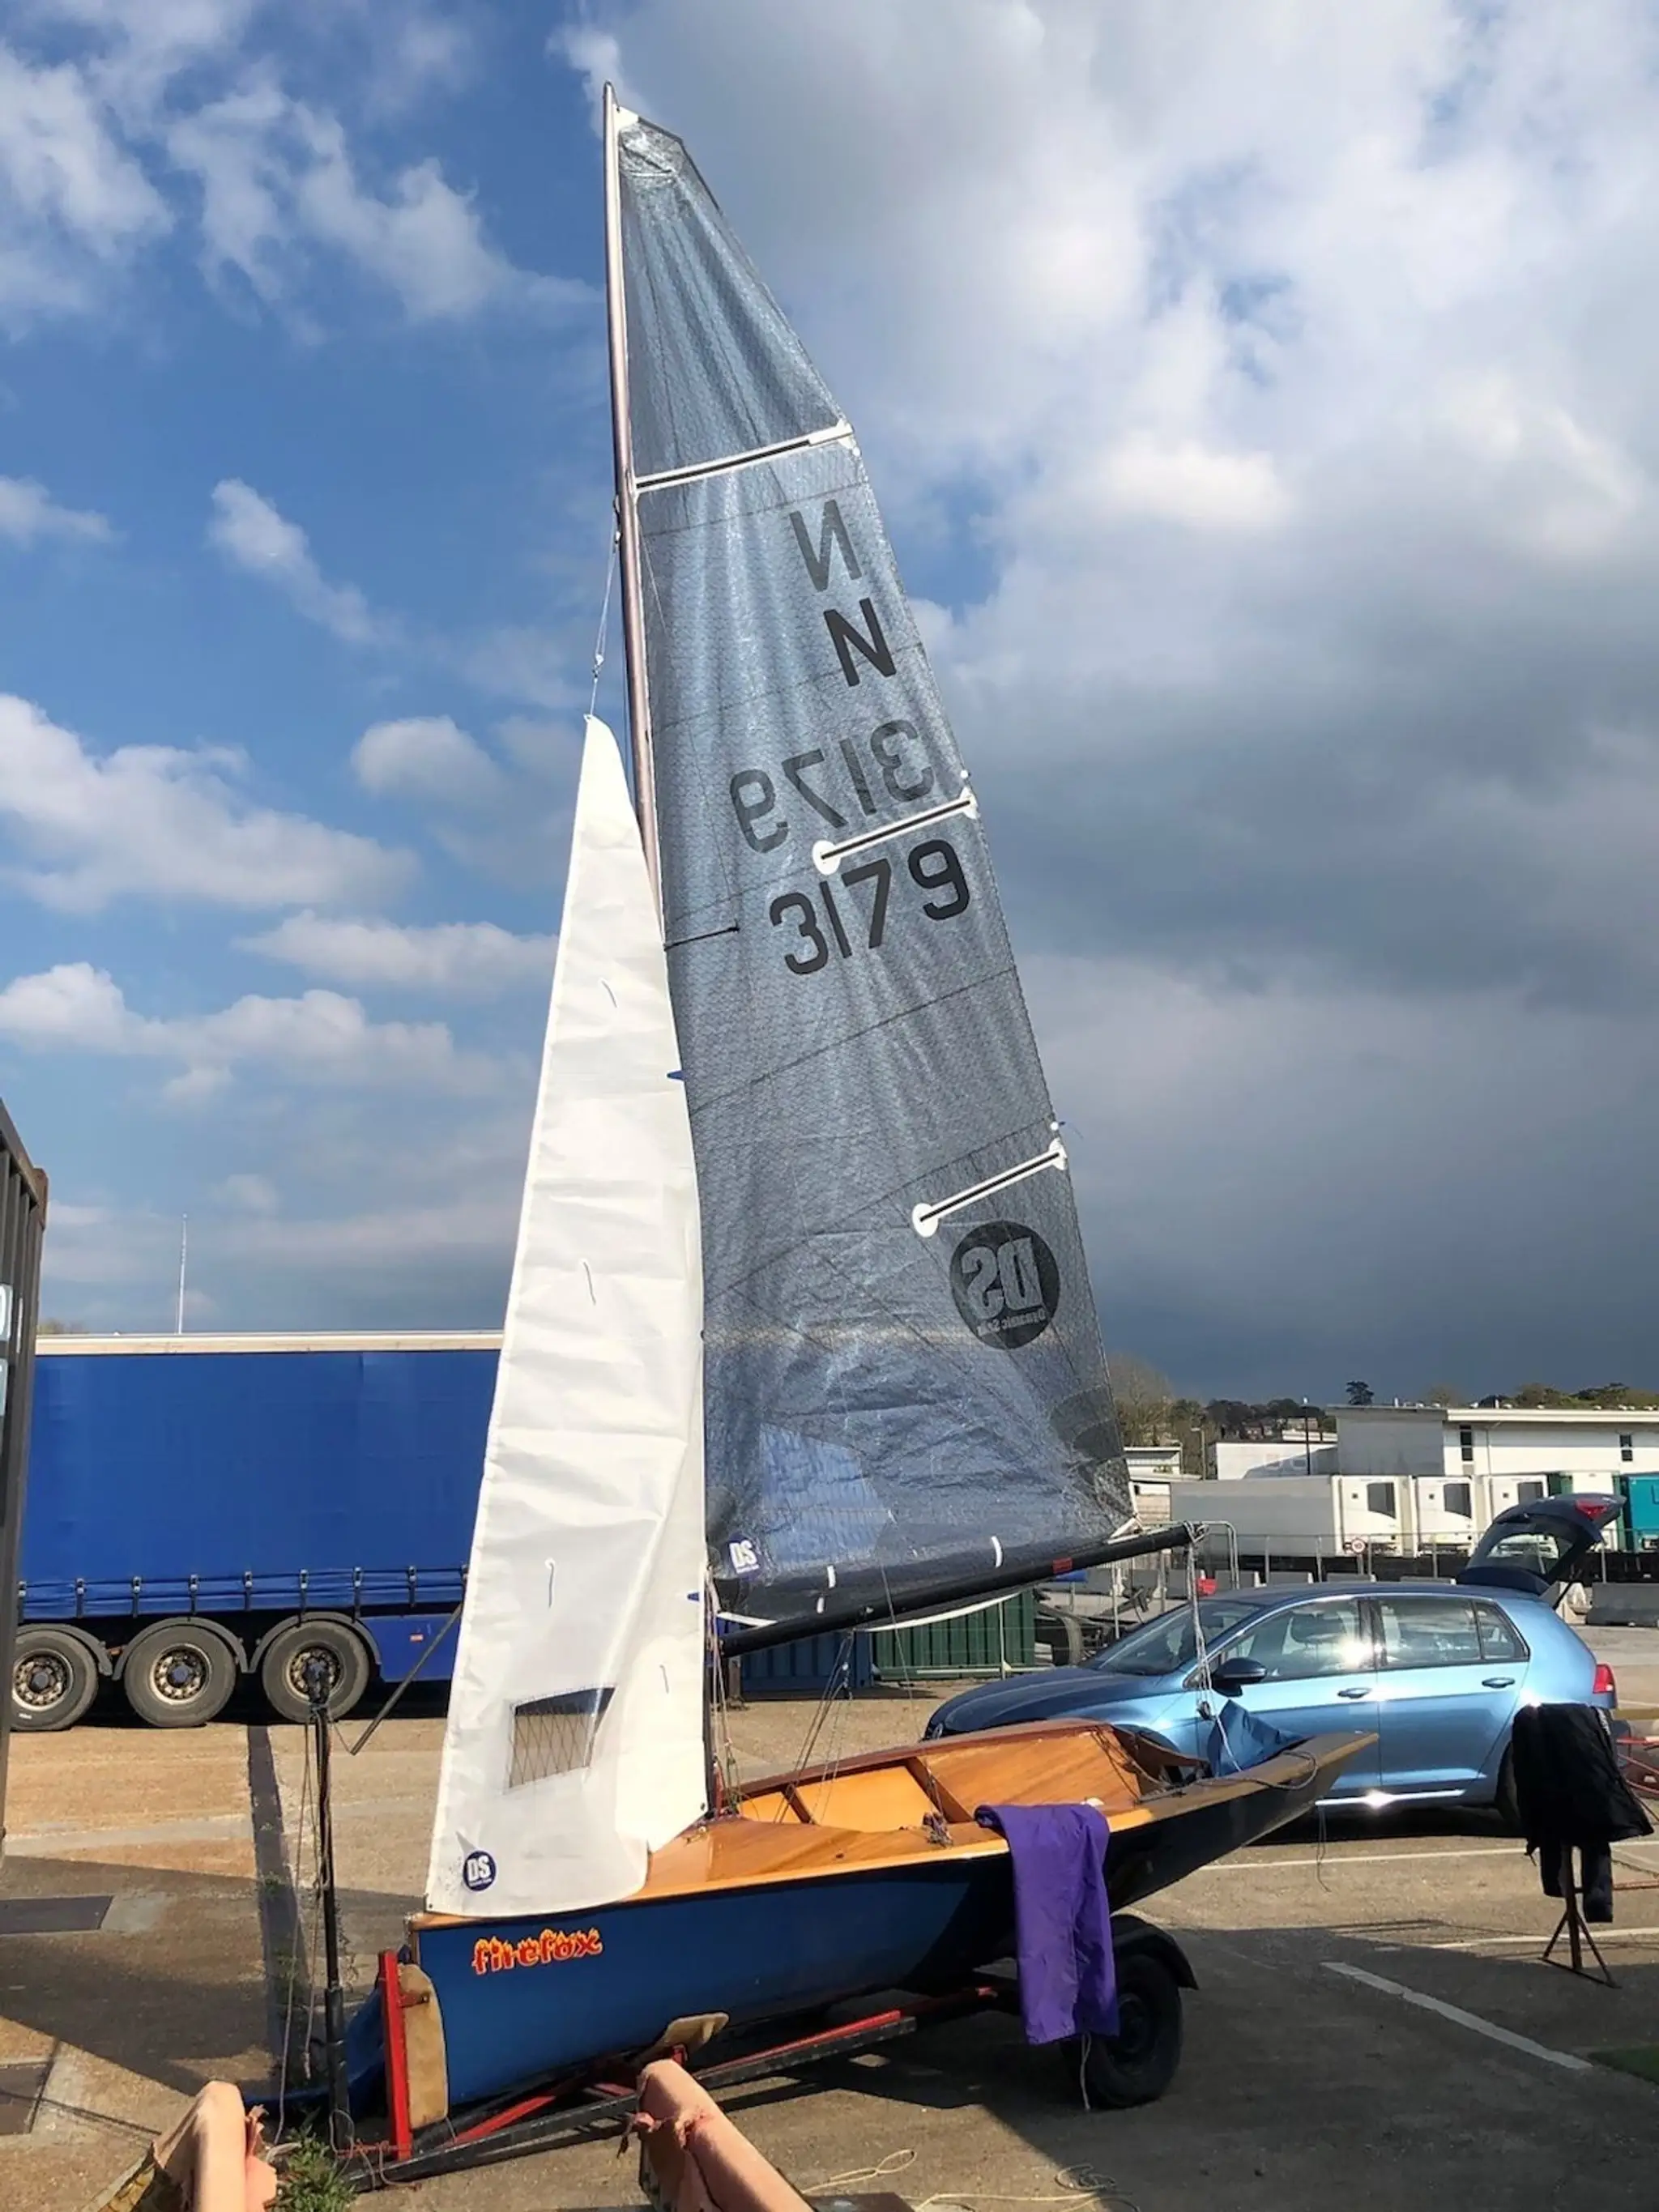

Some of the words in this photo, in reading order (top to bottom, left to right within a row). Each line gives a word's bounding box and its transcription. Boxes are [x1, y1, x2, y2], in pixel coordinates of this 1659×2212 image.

[823, 598, 896, 687] N
[769, 839, 970, 975] 3179
[729, 1540, 757, 1567] DS
[467, 1855, 491, 1881] DS
[472, 1928, 603, 1975] firefox
